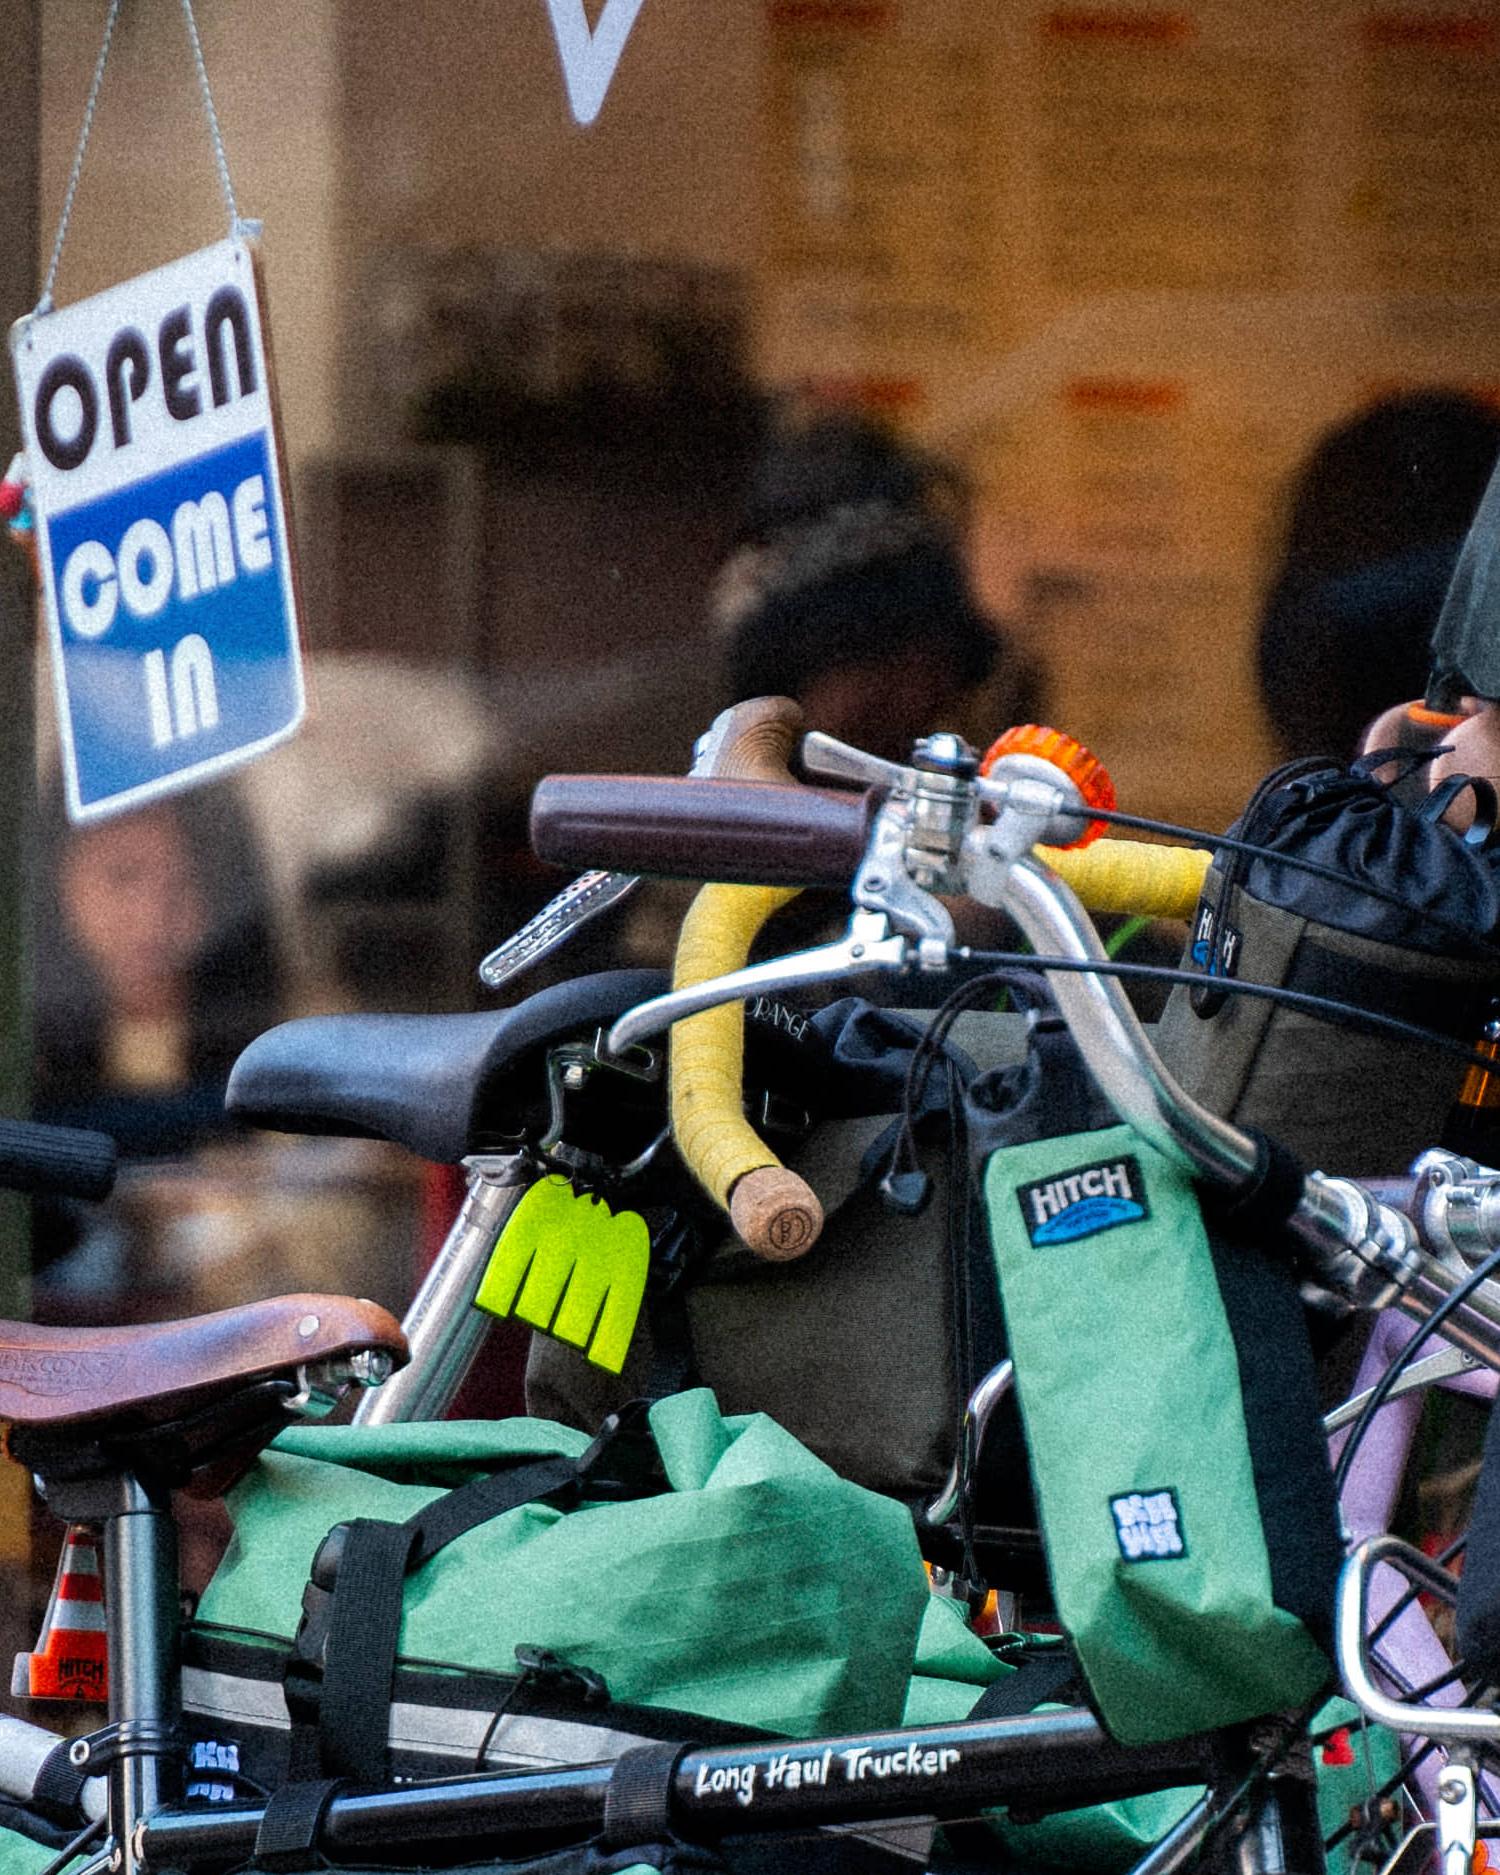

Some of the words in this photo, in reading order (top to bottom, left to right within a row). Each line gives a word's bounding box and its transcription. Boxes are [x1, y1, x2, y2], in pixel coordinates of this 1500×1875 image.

[34, 284, 257, 471] OPEN
[61, 473, 273, 638] COME
[144, 632, 221, 750] IN
[1197, 908, 1237, 969] HIH
[743, 995, 811, 1041] ORANGE
[1032, 1164, 1132, 1224] HITCH
[59, 1657, 104, 1684] HITCH
[693, 1762, 756, 1806] Long
[763, 1750, 833, 1790] Haul
[839, 1743, 961, 1781] Trucker
